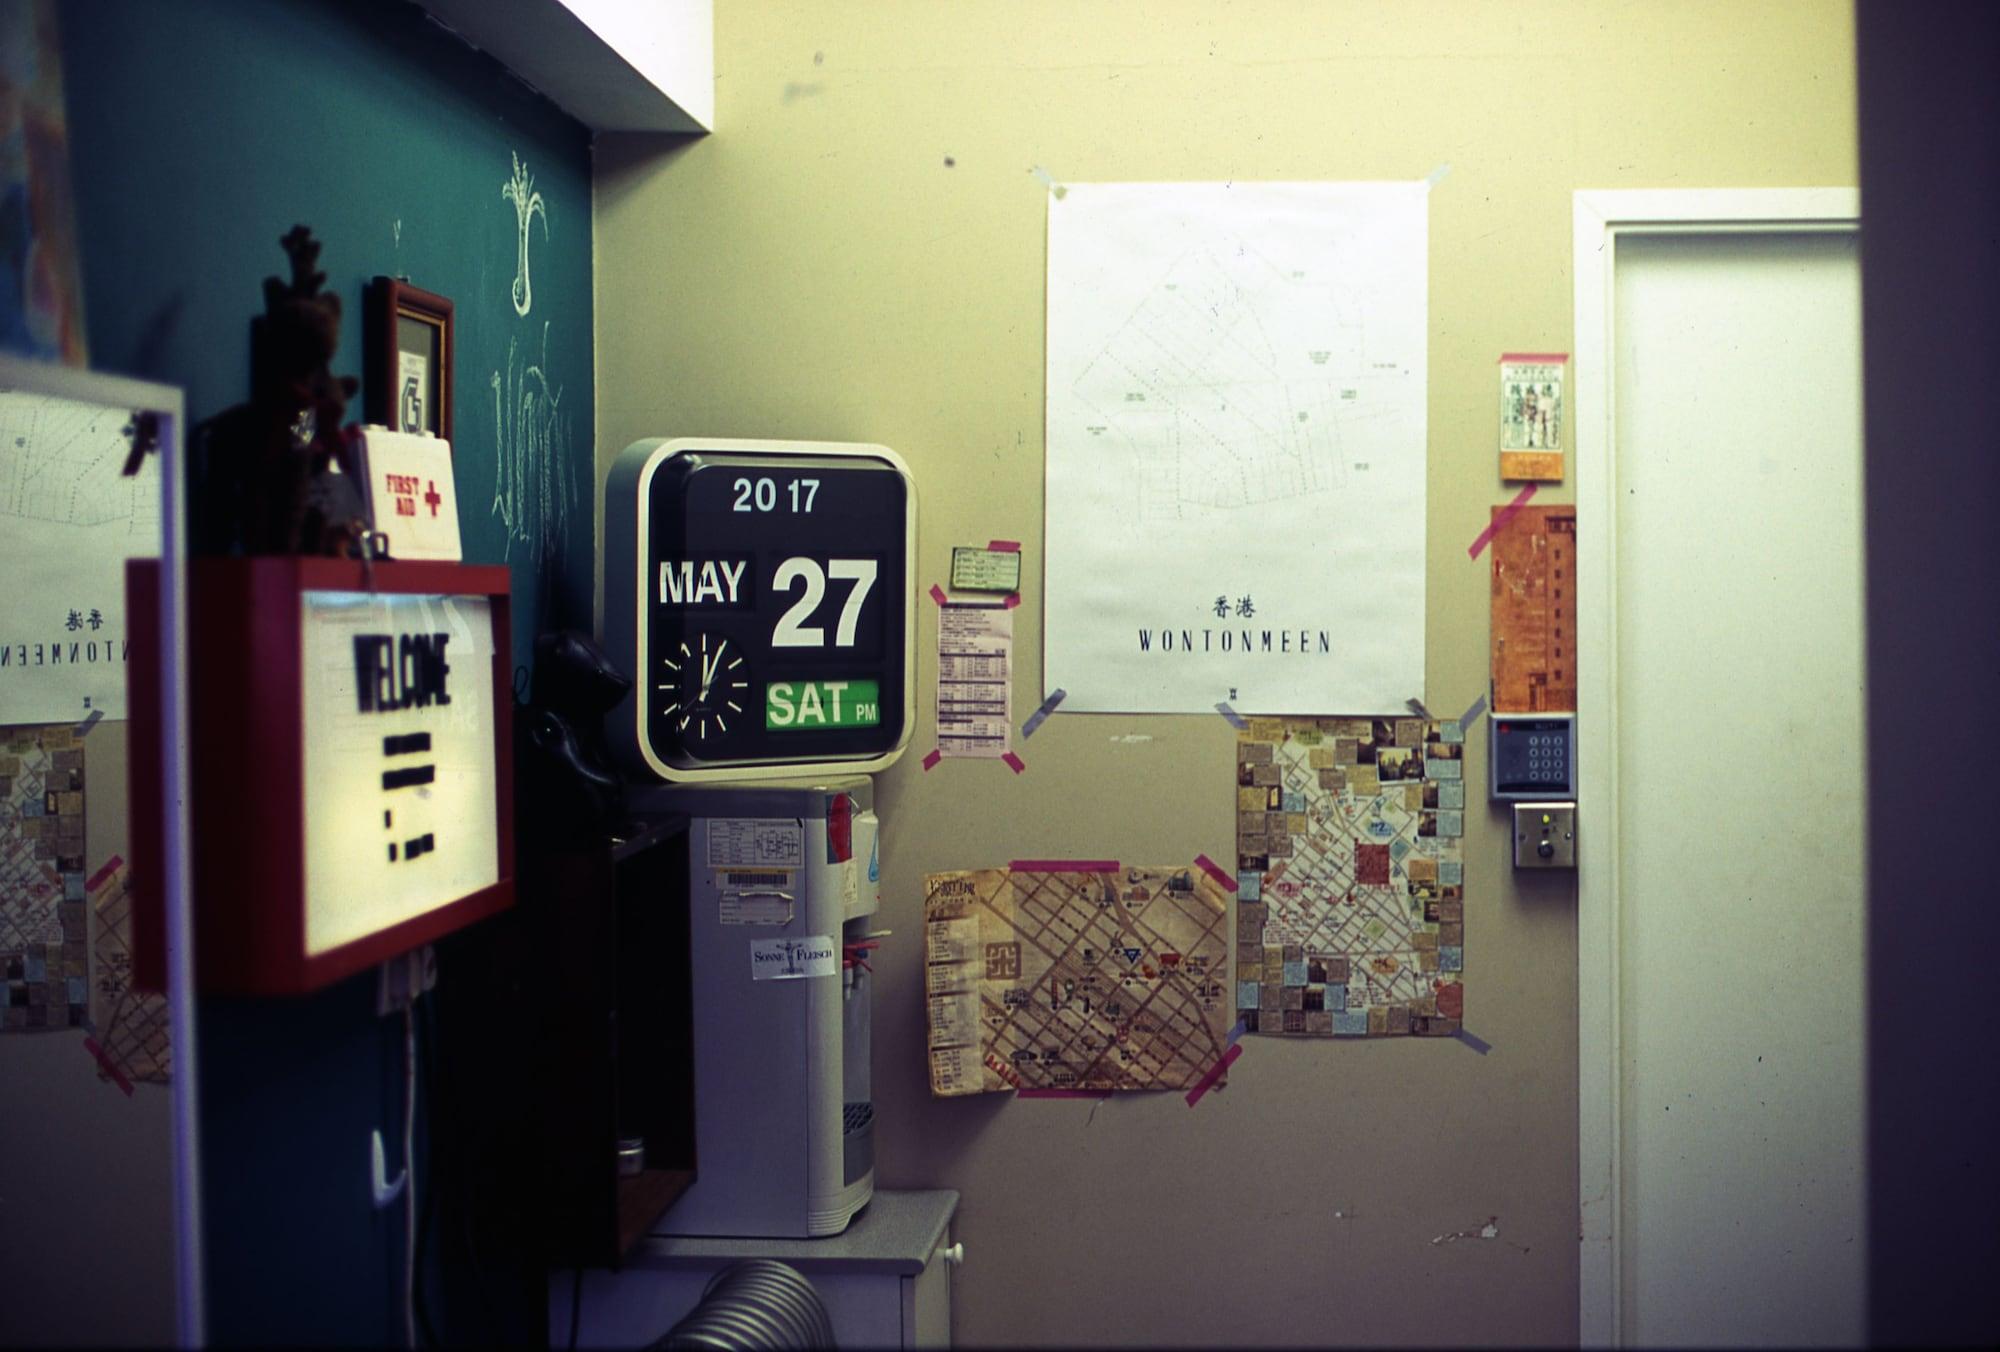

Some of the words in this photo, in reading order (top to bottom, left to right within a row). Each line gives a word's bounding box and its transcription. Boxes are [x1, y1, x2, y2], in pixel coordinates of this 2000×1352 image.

[385, 474, 420, 496] FIRST
[395, 497, 417, 518] AID
[659, 560, 747, 605] MAY
[772, 556, 879, 648] 27
[1212, 594, 1257, 619] 香港
[1139, 628, 1331, 654] WONTONMEEN
[768, 682, 850, 726] SAT
[855, 704, 877, 722] PM
